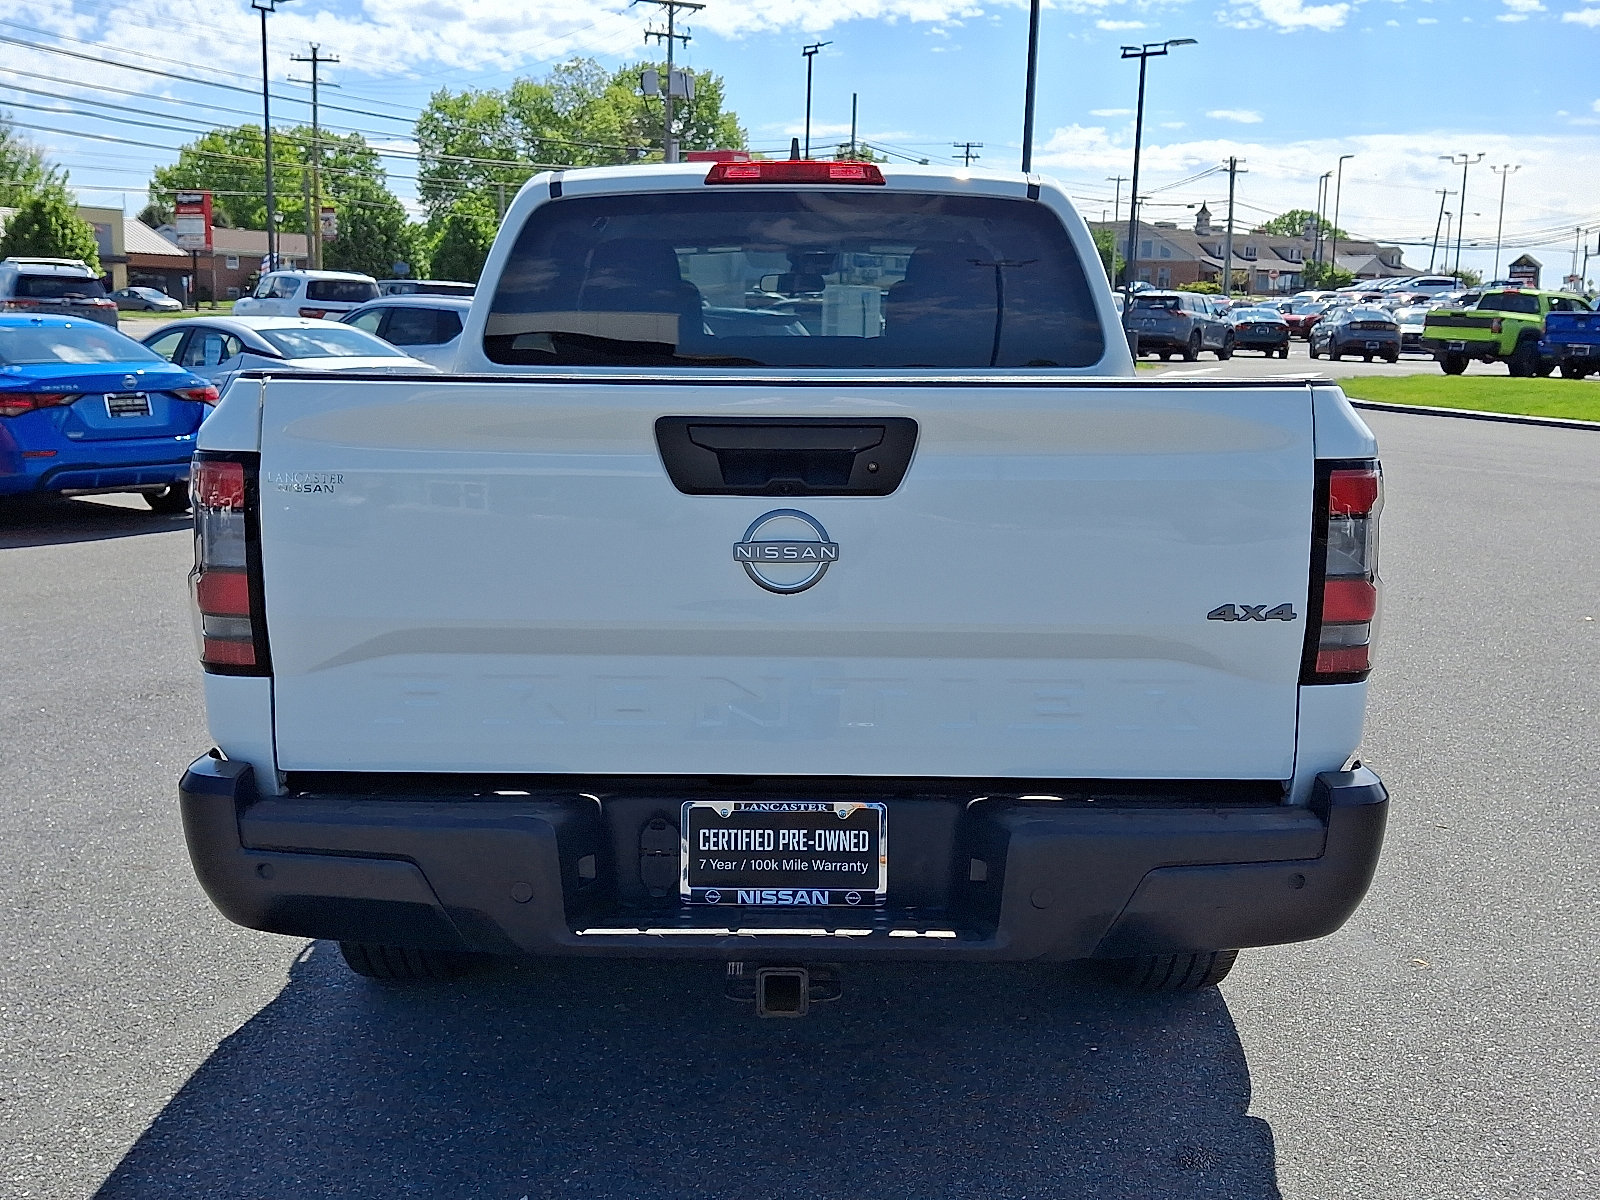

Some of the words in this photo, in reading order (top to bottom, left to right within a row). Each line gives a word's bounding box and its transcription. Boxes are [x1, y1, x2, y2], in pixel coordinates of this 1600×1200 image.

[267, 472, 344, 484] LANCASTER
[277, 484, 335, 493] NISSAN
[736, 546, 836, 559] NISSAN
[740, 803, 828, 812] LANCASTER
[699, 829, 774, 851] CERTIFIED
[779, 829, 869, 852] PRE-OWNED
[699, 859, 707, 870] 7
[709, 859, 737, 871] Year
[740, 859, 746, 871] /
[750, 859, 779, 871] 100k
[782, 859, 808, 871] Mile
[812, 859, 869, 875] Warranty
[737, 890, 829, 905] NISSAN
